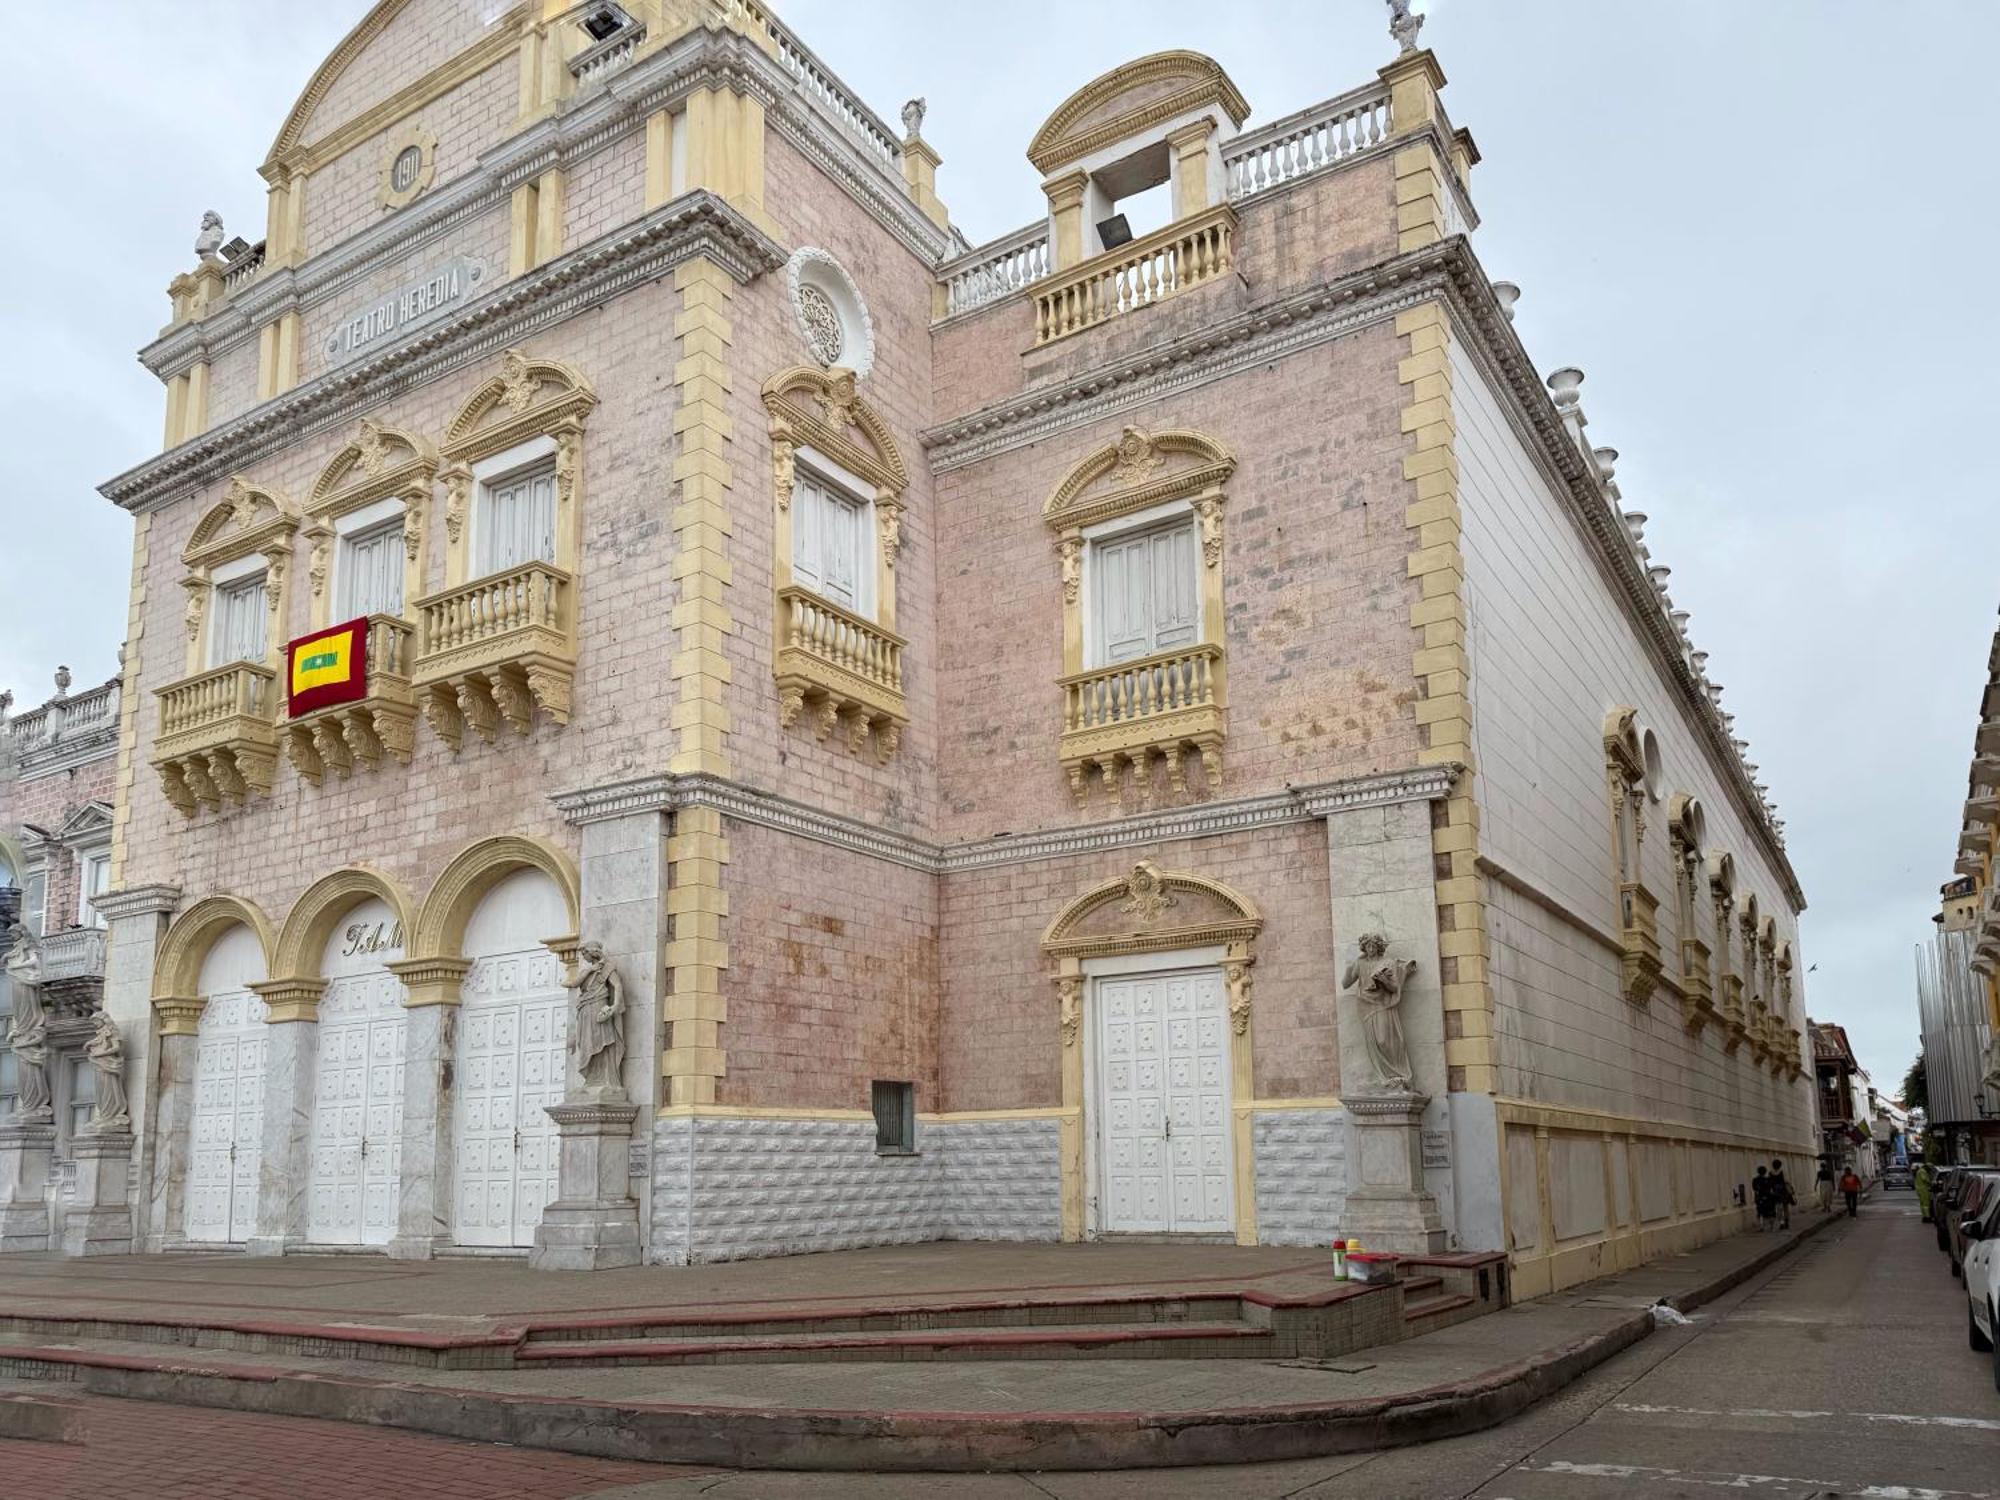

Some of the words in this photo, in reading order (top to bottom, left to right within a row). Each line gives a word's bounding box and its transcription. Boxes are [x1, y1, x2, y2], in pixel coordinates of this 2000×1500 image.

[397, 151, 419, 189] 1911
[345, 303, 395, 352] TEATRO
[399, 268, 459, 324] HEREDIA
